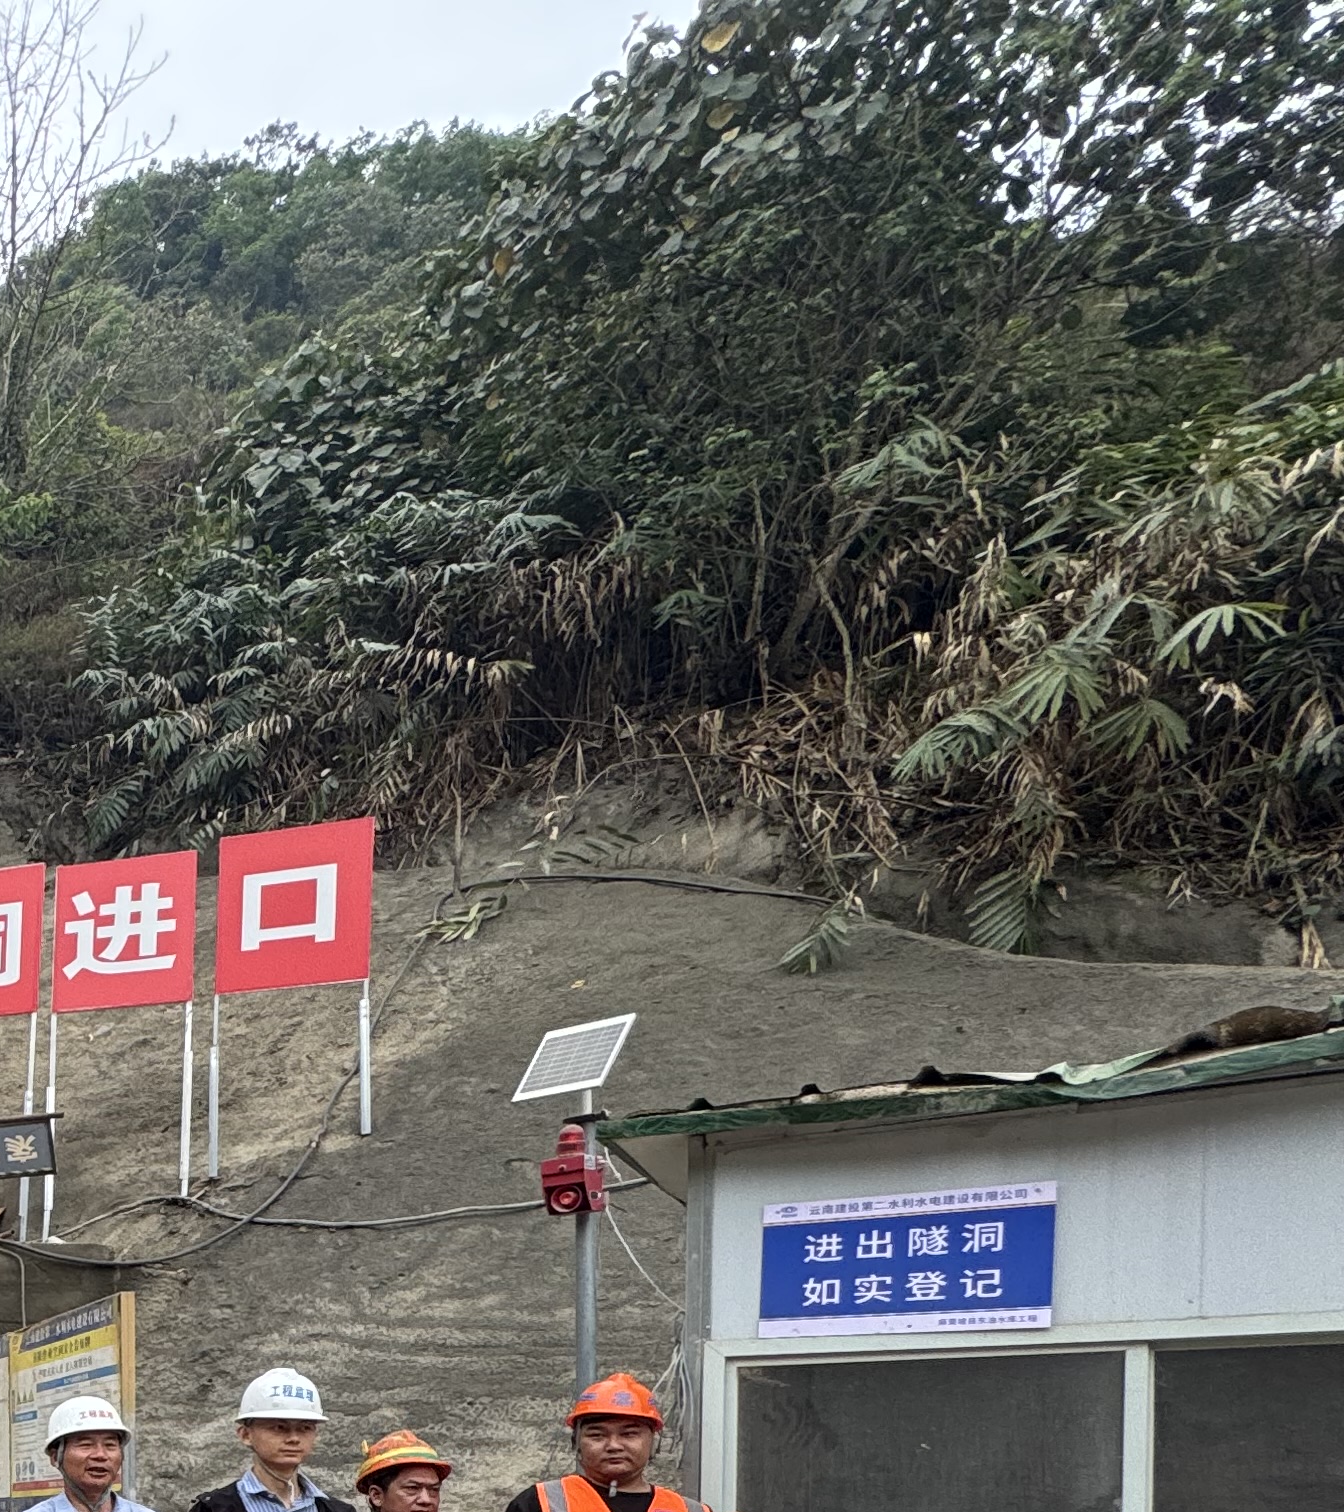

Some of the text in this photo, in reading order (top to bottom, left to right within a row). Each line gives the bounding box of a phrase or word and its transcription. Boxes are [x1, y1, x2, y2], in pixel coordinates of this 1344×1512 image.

[809, 1188, 1028, 1216] 云南建投第二水利水电建设有限公司
[803, 1221, 1004, 1263] 进出隧洞
[802, 1269, 1003, 1307] 如实登记
[270, 1385, 314, 1402] 工程监理
